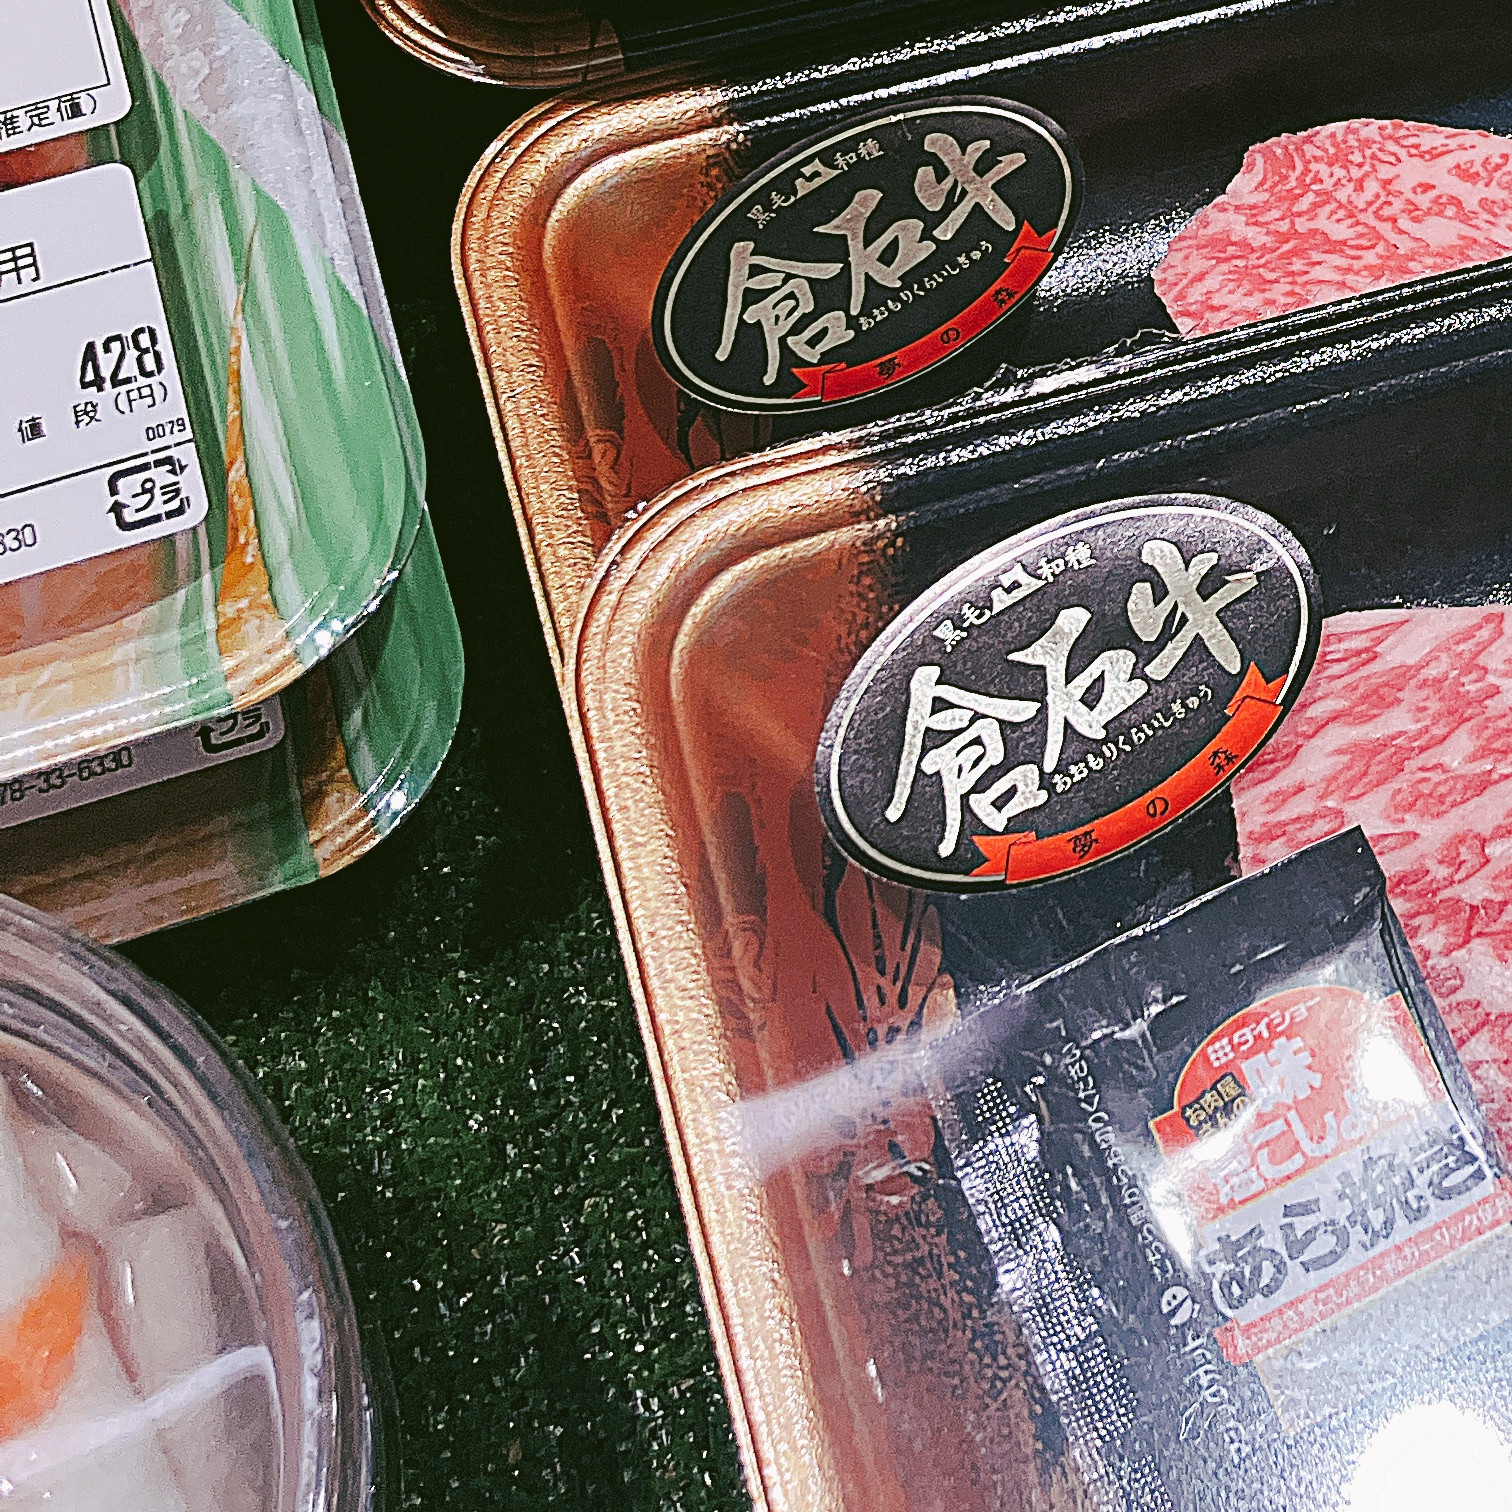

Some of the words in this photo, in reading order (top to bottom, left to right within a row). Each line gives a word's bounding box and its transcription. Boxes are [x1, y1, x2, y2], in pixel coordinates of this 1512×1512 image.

[714, 132, 1027, 386] 倉石牛
[858, 239, 995, 332] あおもりくらいしぎゅう
[79, 325, 165, 394] 428
[145, 416, 187, 442] 0079
[884, 538, 1260, 860] 倉石牛
[1050, 683, 1214, 795] あおもりくらいしぎゅう
[1233, 995, 1322, 1053] ダイショー
[1184, 1074, 1244, 1127] お肉屋
[1240, 1036, 1322, 1112] 味
